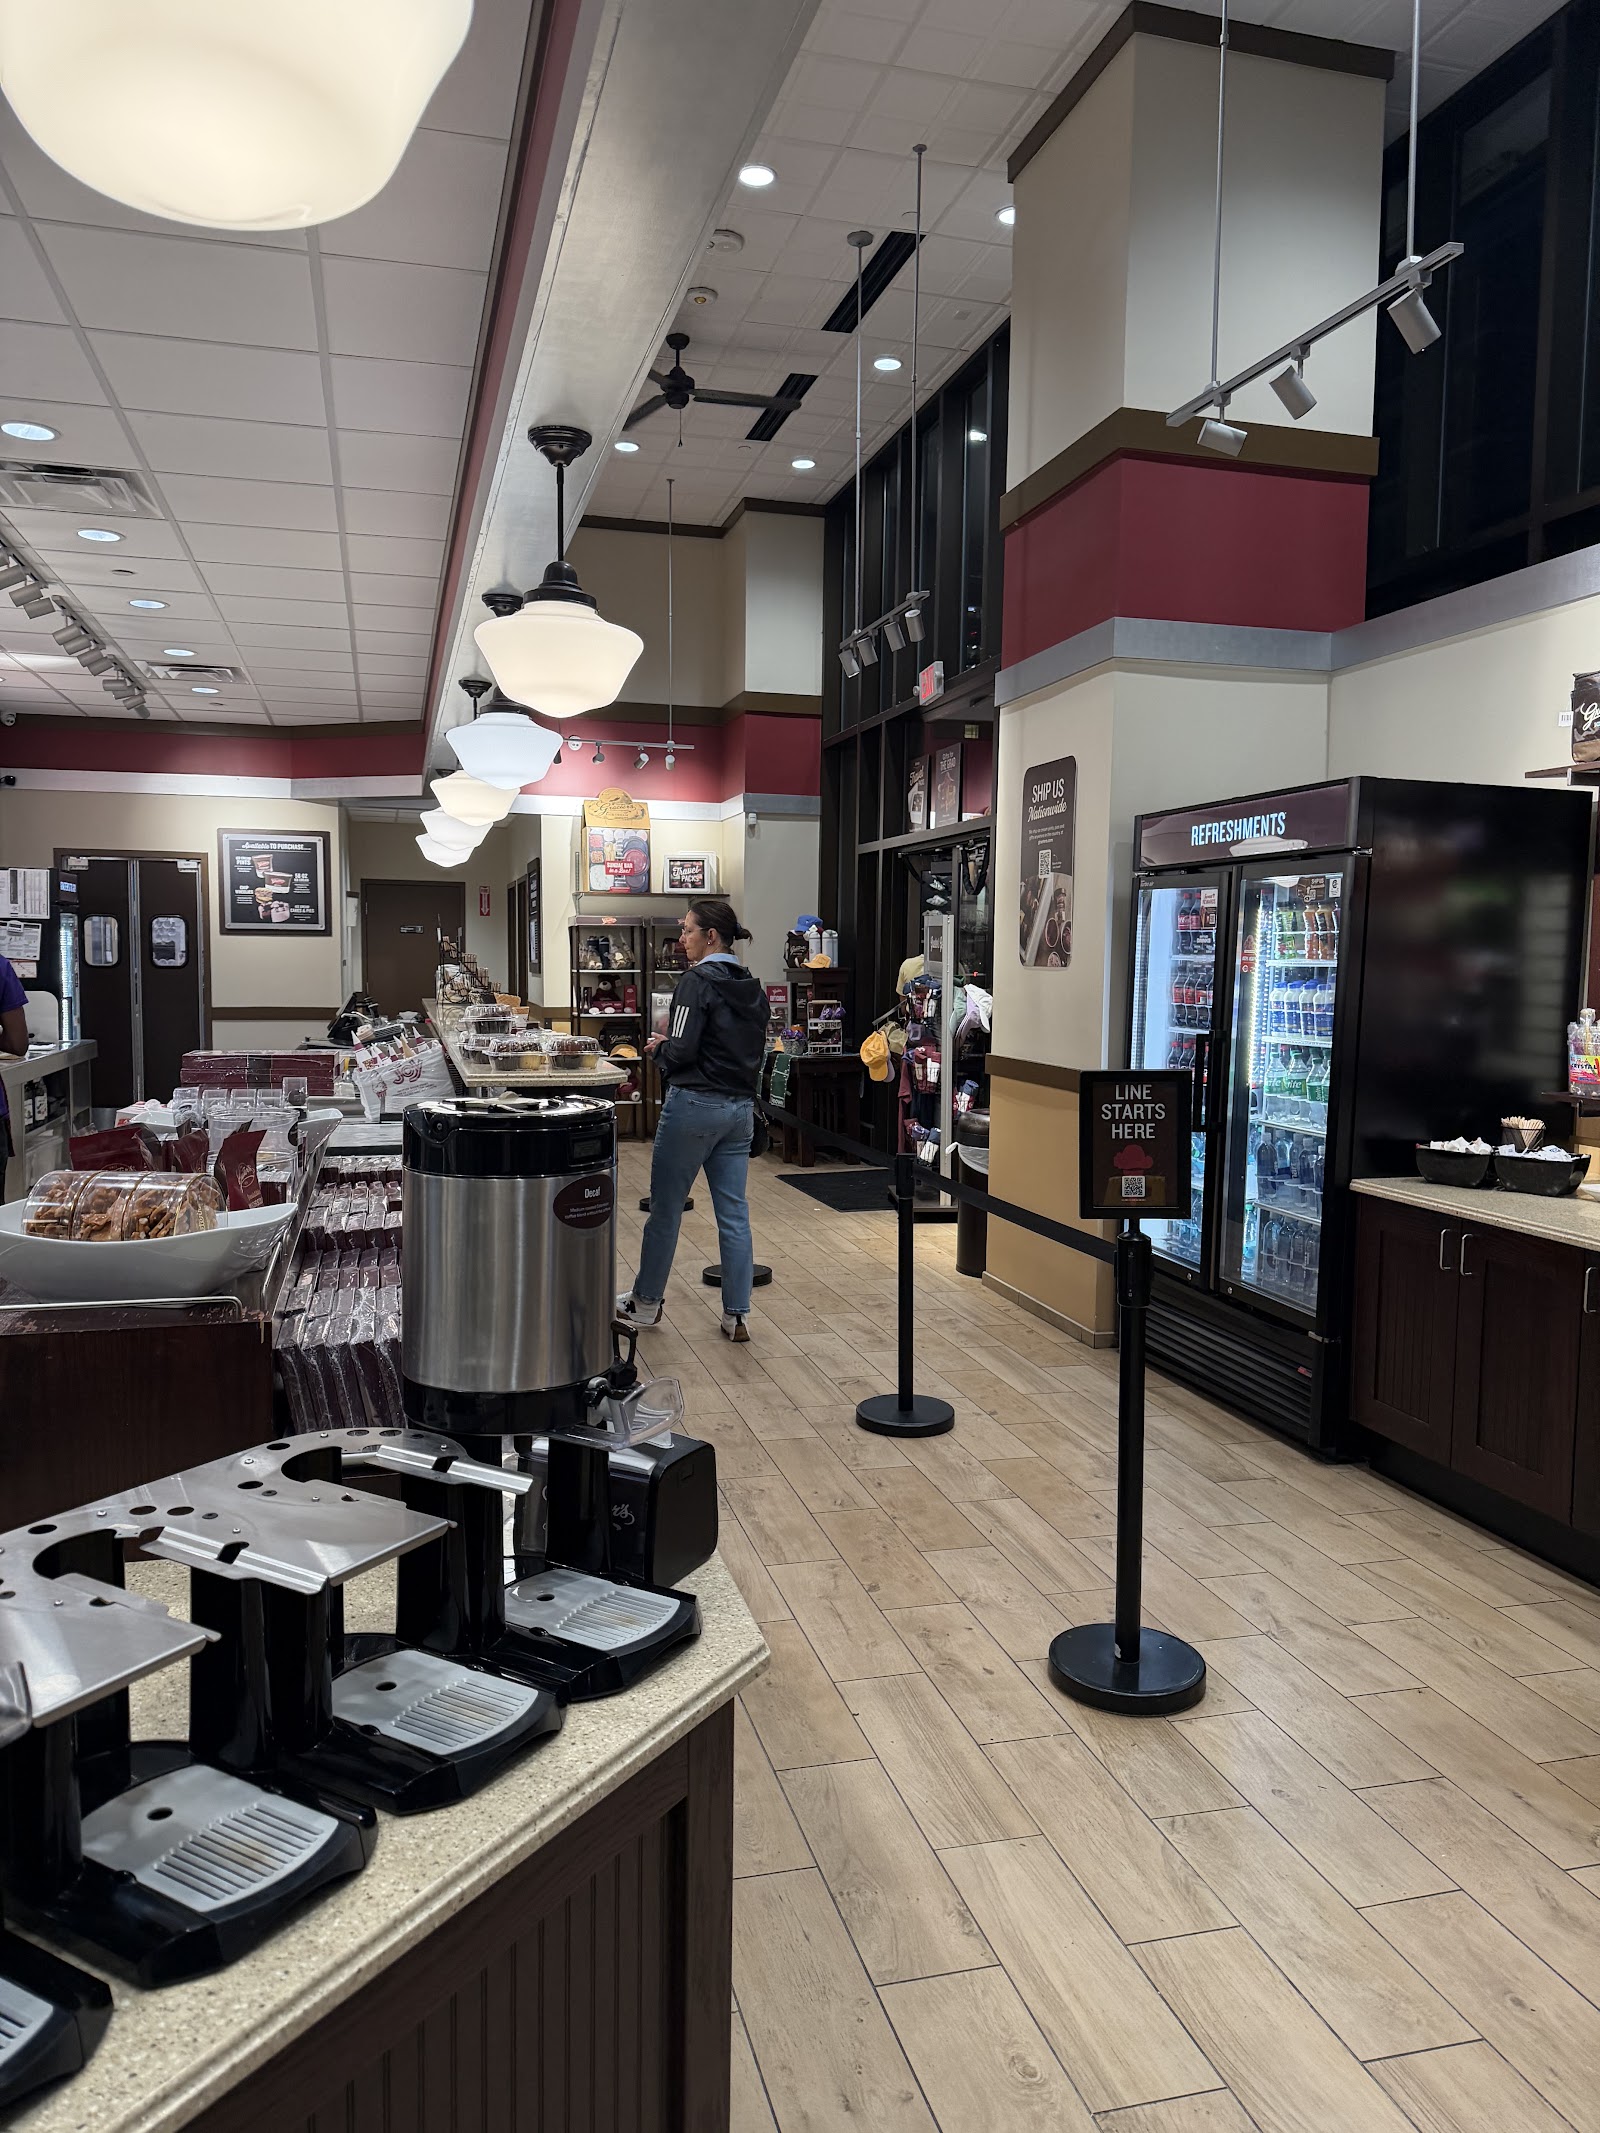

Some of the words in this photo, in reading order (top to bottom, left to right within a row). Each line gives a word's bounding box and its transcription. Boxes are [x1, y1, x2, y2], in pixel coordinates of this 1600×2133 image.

[921, 666, 935, 700] EXIT
[1032, 782, 1052, 803] SHIP
[1052, 778, 1065, 799] US
[1027, 798, 1068, 822] Nationwide
[1190, 813, 1286, 846] REFRESHMENTS
[672, 866, 701, 877] Travel
[1115, 1084, 1152, 1100] LINE
[1101, 1103, 1166, 1120] STARTS
[1111, 1123, 1156, 1139] HERE
[584, 1186, 601, 1199] Decaf
